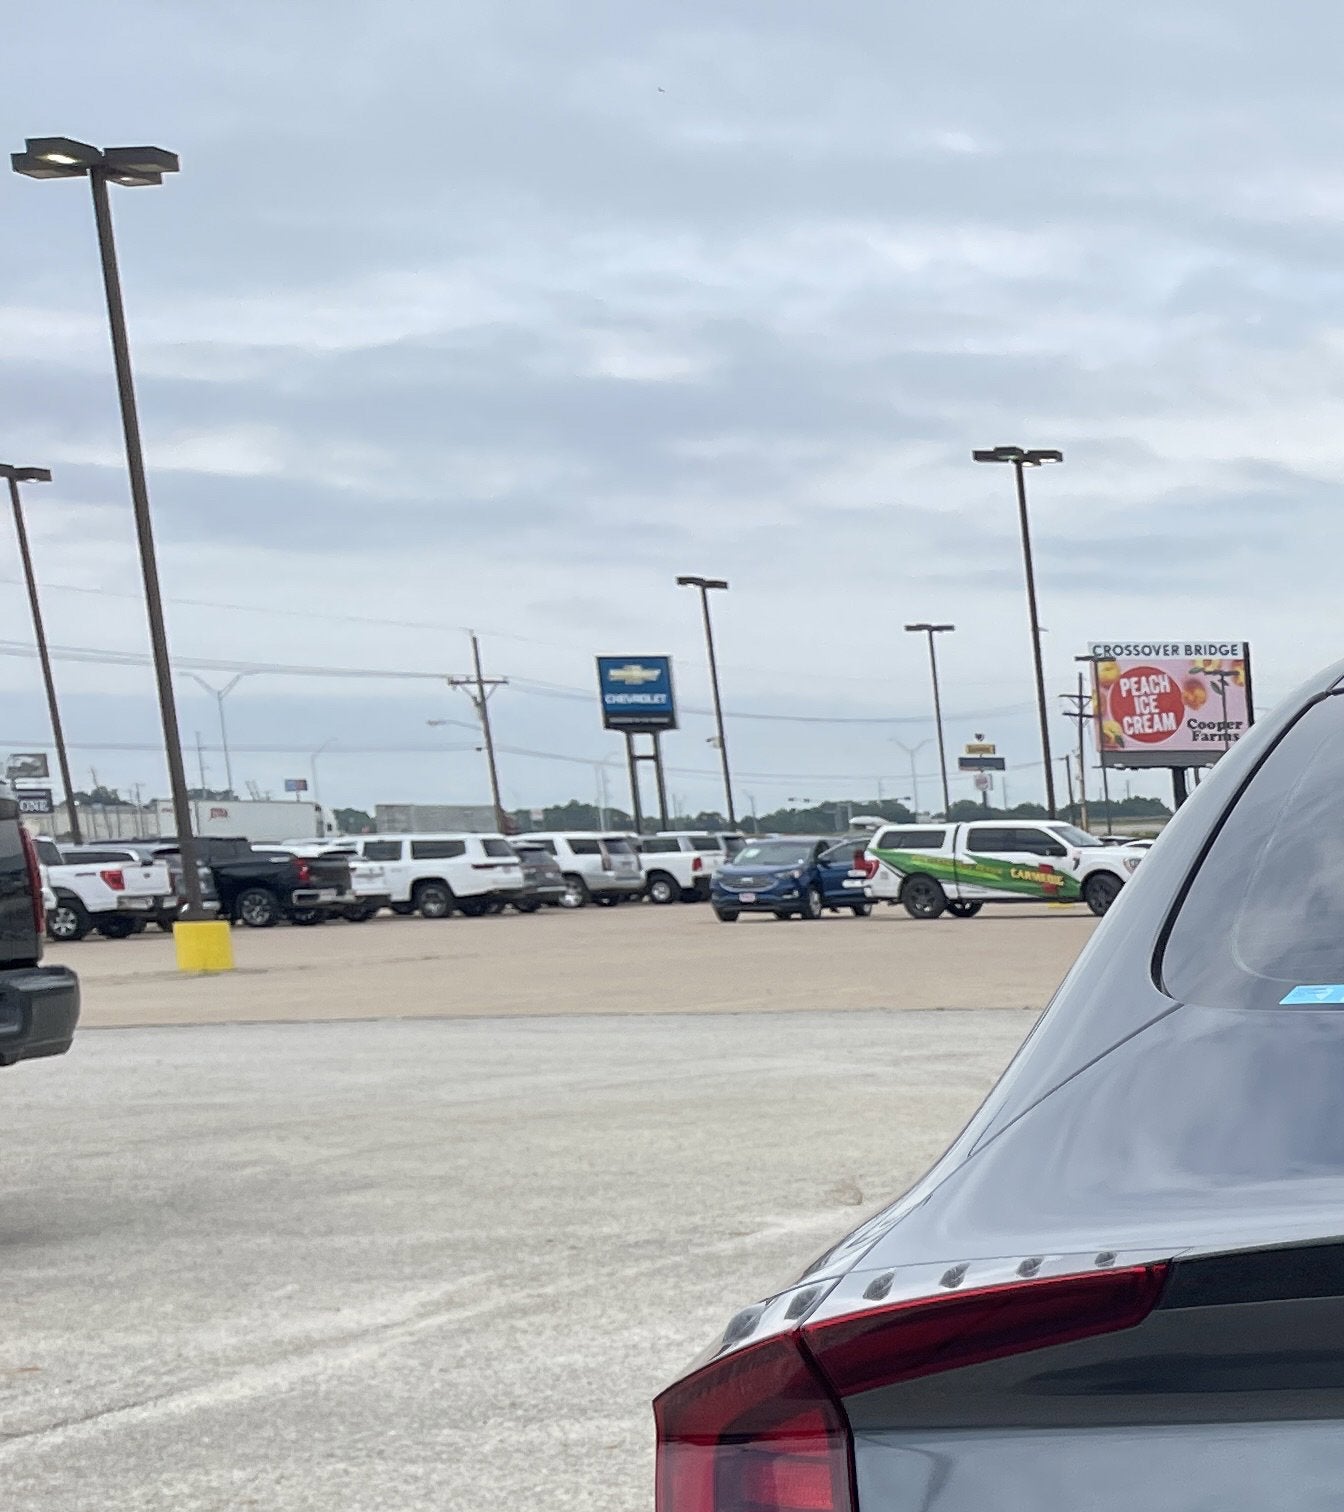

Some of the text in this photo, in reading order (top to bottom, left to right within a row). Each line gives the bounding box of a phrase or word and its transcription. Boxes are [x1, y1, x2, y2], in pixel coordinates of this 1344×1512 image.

[1092, 644, 1239, 657] CROSSOVER BRIDGE
[1120, 674, 1171, 698] PEACH
[1133, 696, 1160, 716] ICE
[1123, 712, 1177, 735] CREAM
[1186, 718, 1243, 732] Cooper
[1191, 731, 1240, 742] Farms
